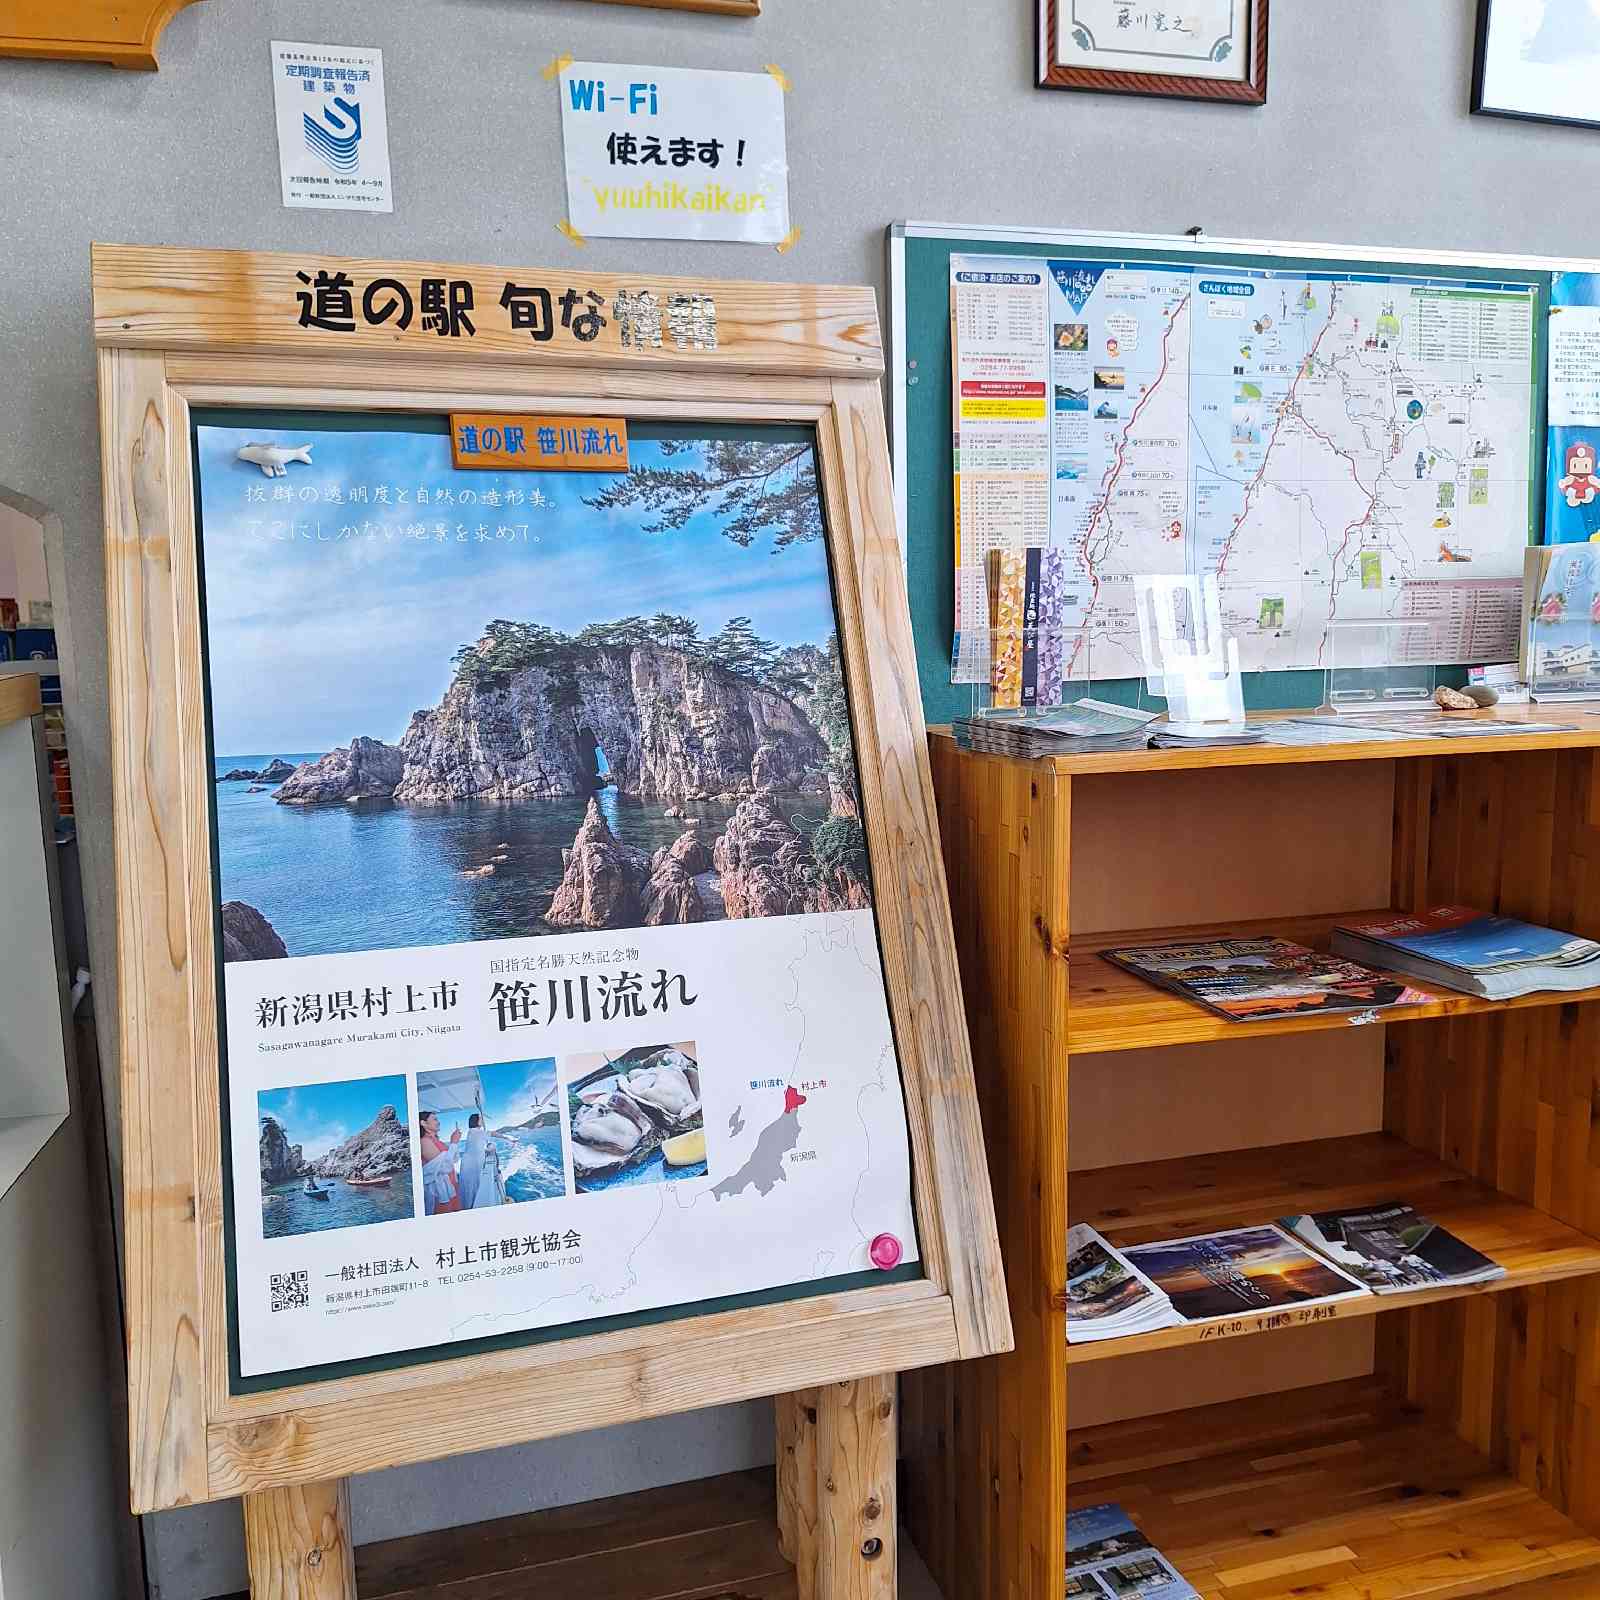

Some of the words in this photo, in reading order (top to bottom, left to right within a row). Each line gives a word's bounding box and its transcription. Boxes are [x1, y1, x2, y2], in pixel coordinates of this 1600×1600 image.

[286, 65, 370, 82] 定期調査報告済
[569, 79, 658, 115] Wi-Fi
[296, 270, 476, 338] 道の駅
[458, 426, 527, 455] 道の駅
[537, 427, 624, 456] 笹川流れ
[490, 947, 640, 974] 国指定名勝天然記念物
[255, 980, 460, 1030] 新潟県村上市
[488, 967, 699, 1032] 笹川流れ
[257, 1036, 344, 1053] Sasagawanagare
[347, 1029, 398, 1044] Murakami
[426, 1022, 461, 1037] Niigata
[324, 1255, 420, 1282] 一般社団法人
[435, 1228, 583, 1270] 村上市観光協会
